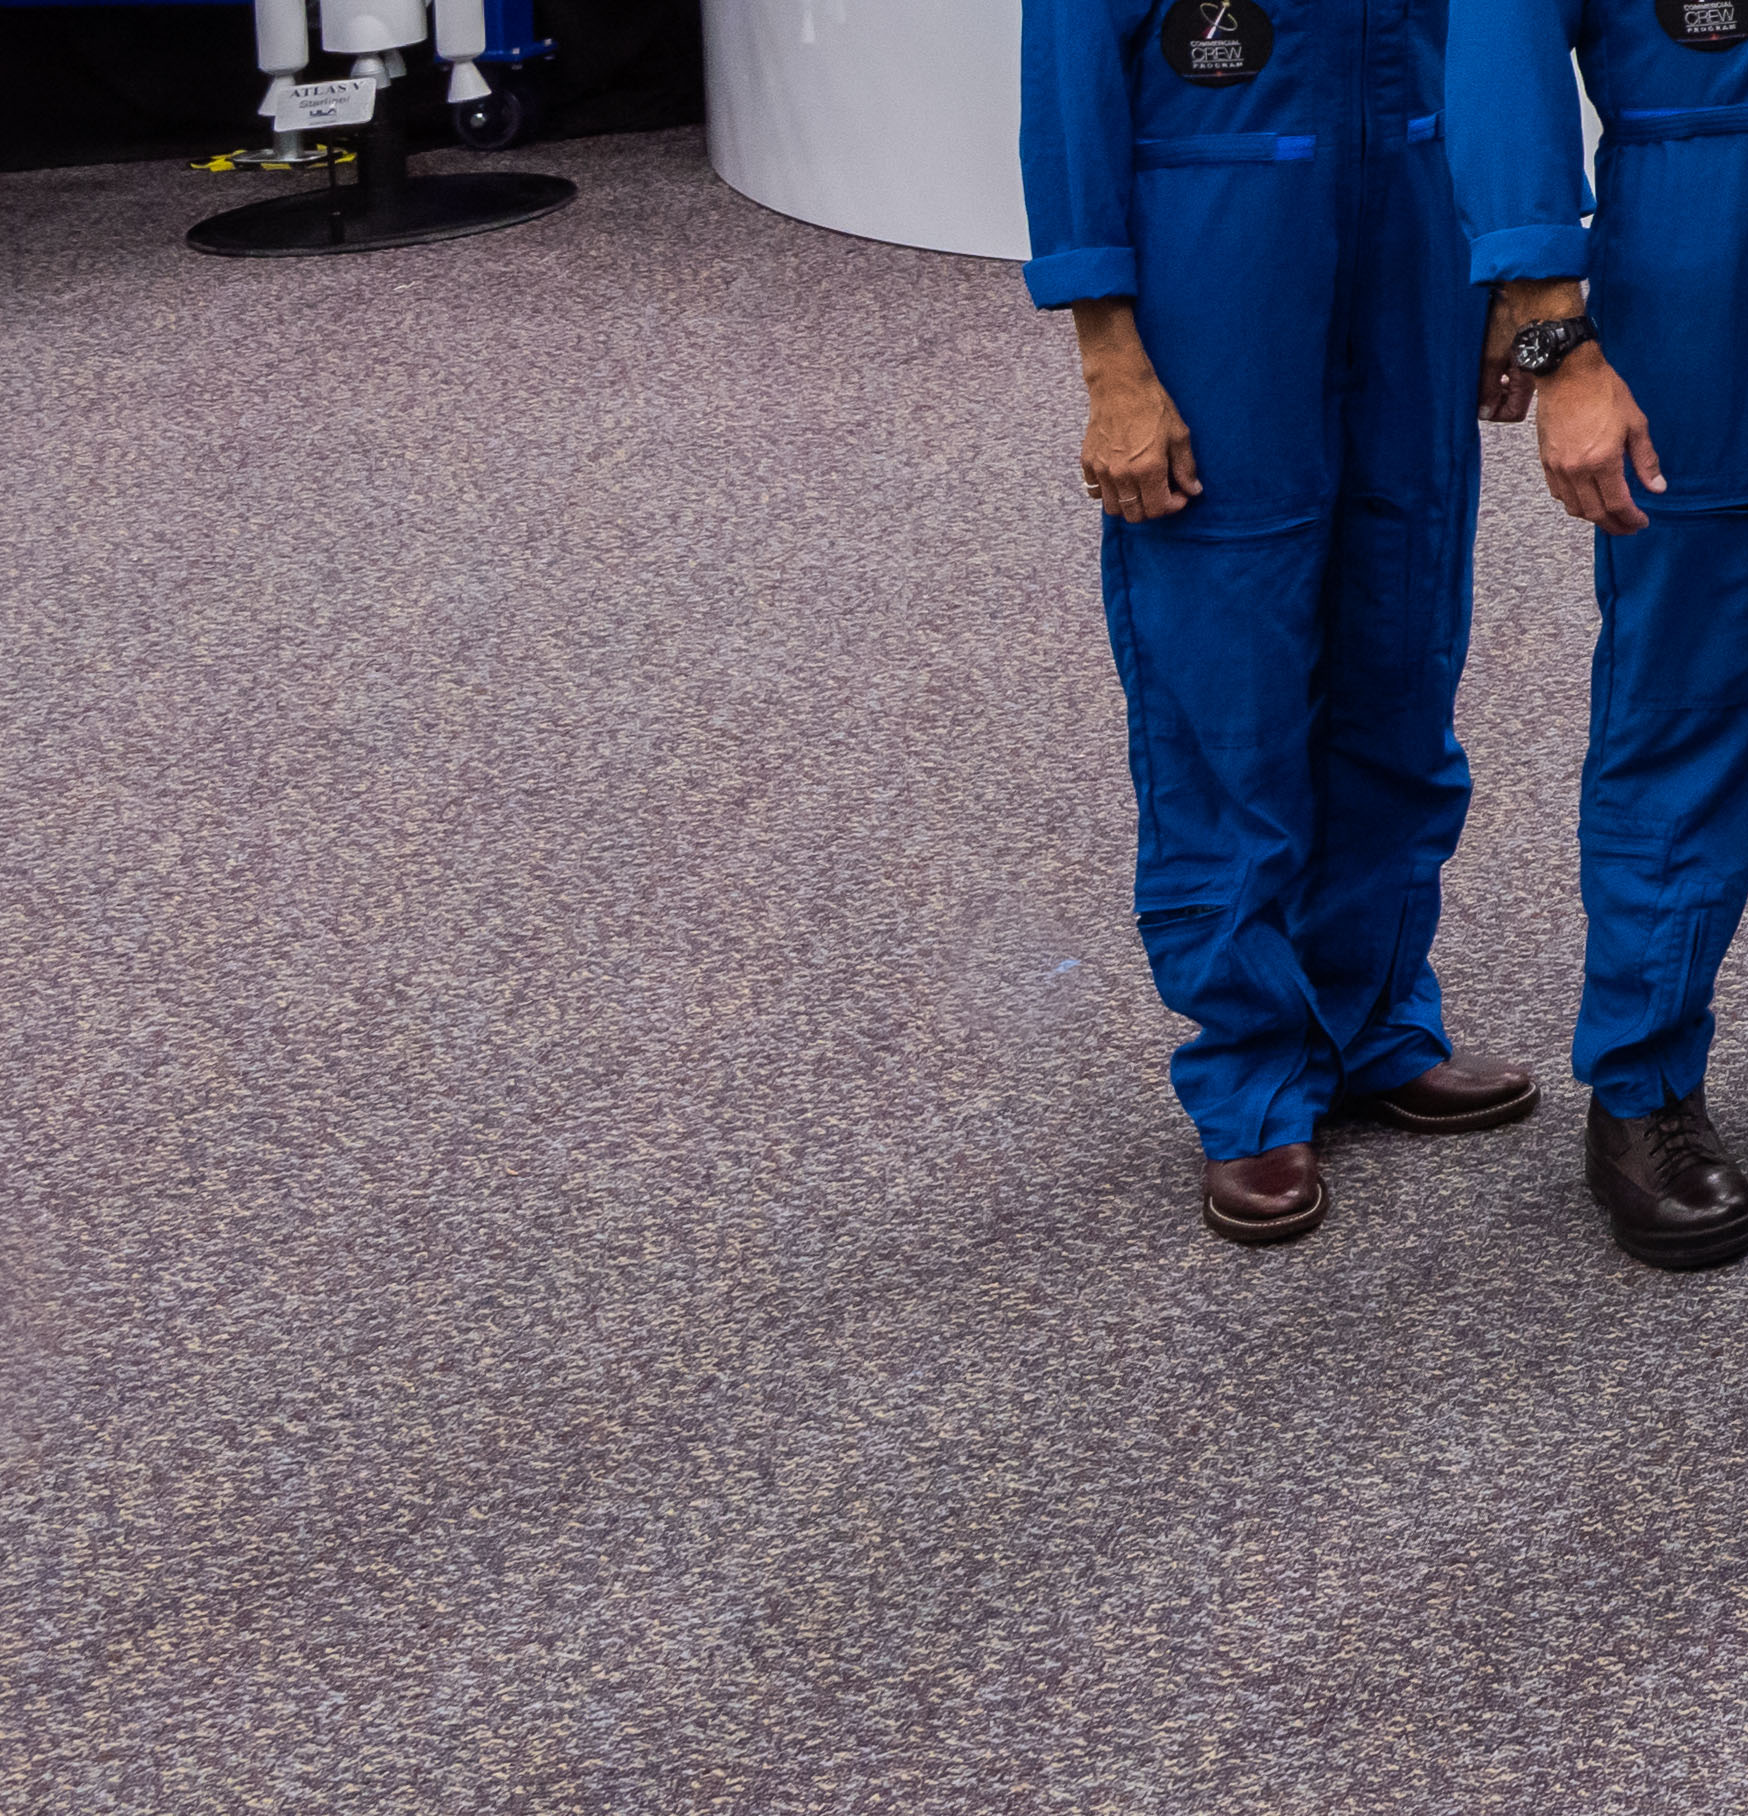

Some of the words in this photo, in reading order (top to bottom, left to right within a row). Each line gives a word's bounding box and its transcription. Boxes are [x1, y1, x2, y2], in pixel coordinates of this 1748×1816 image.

[1685, 7, 1735, 25] CREW
[1191, 46, 1243, 62] CREW
[290, 85, 347, 98] ATLAS
